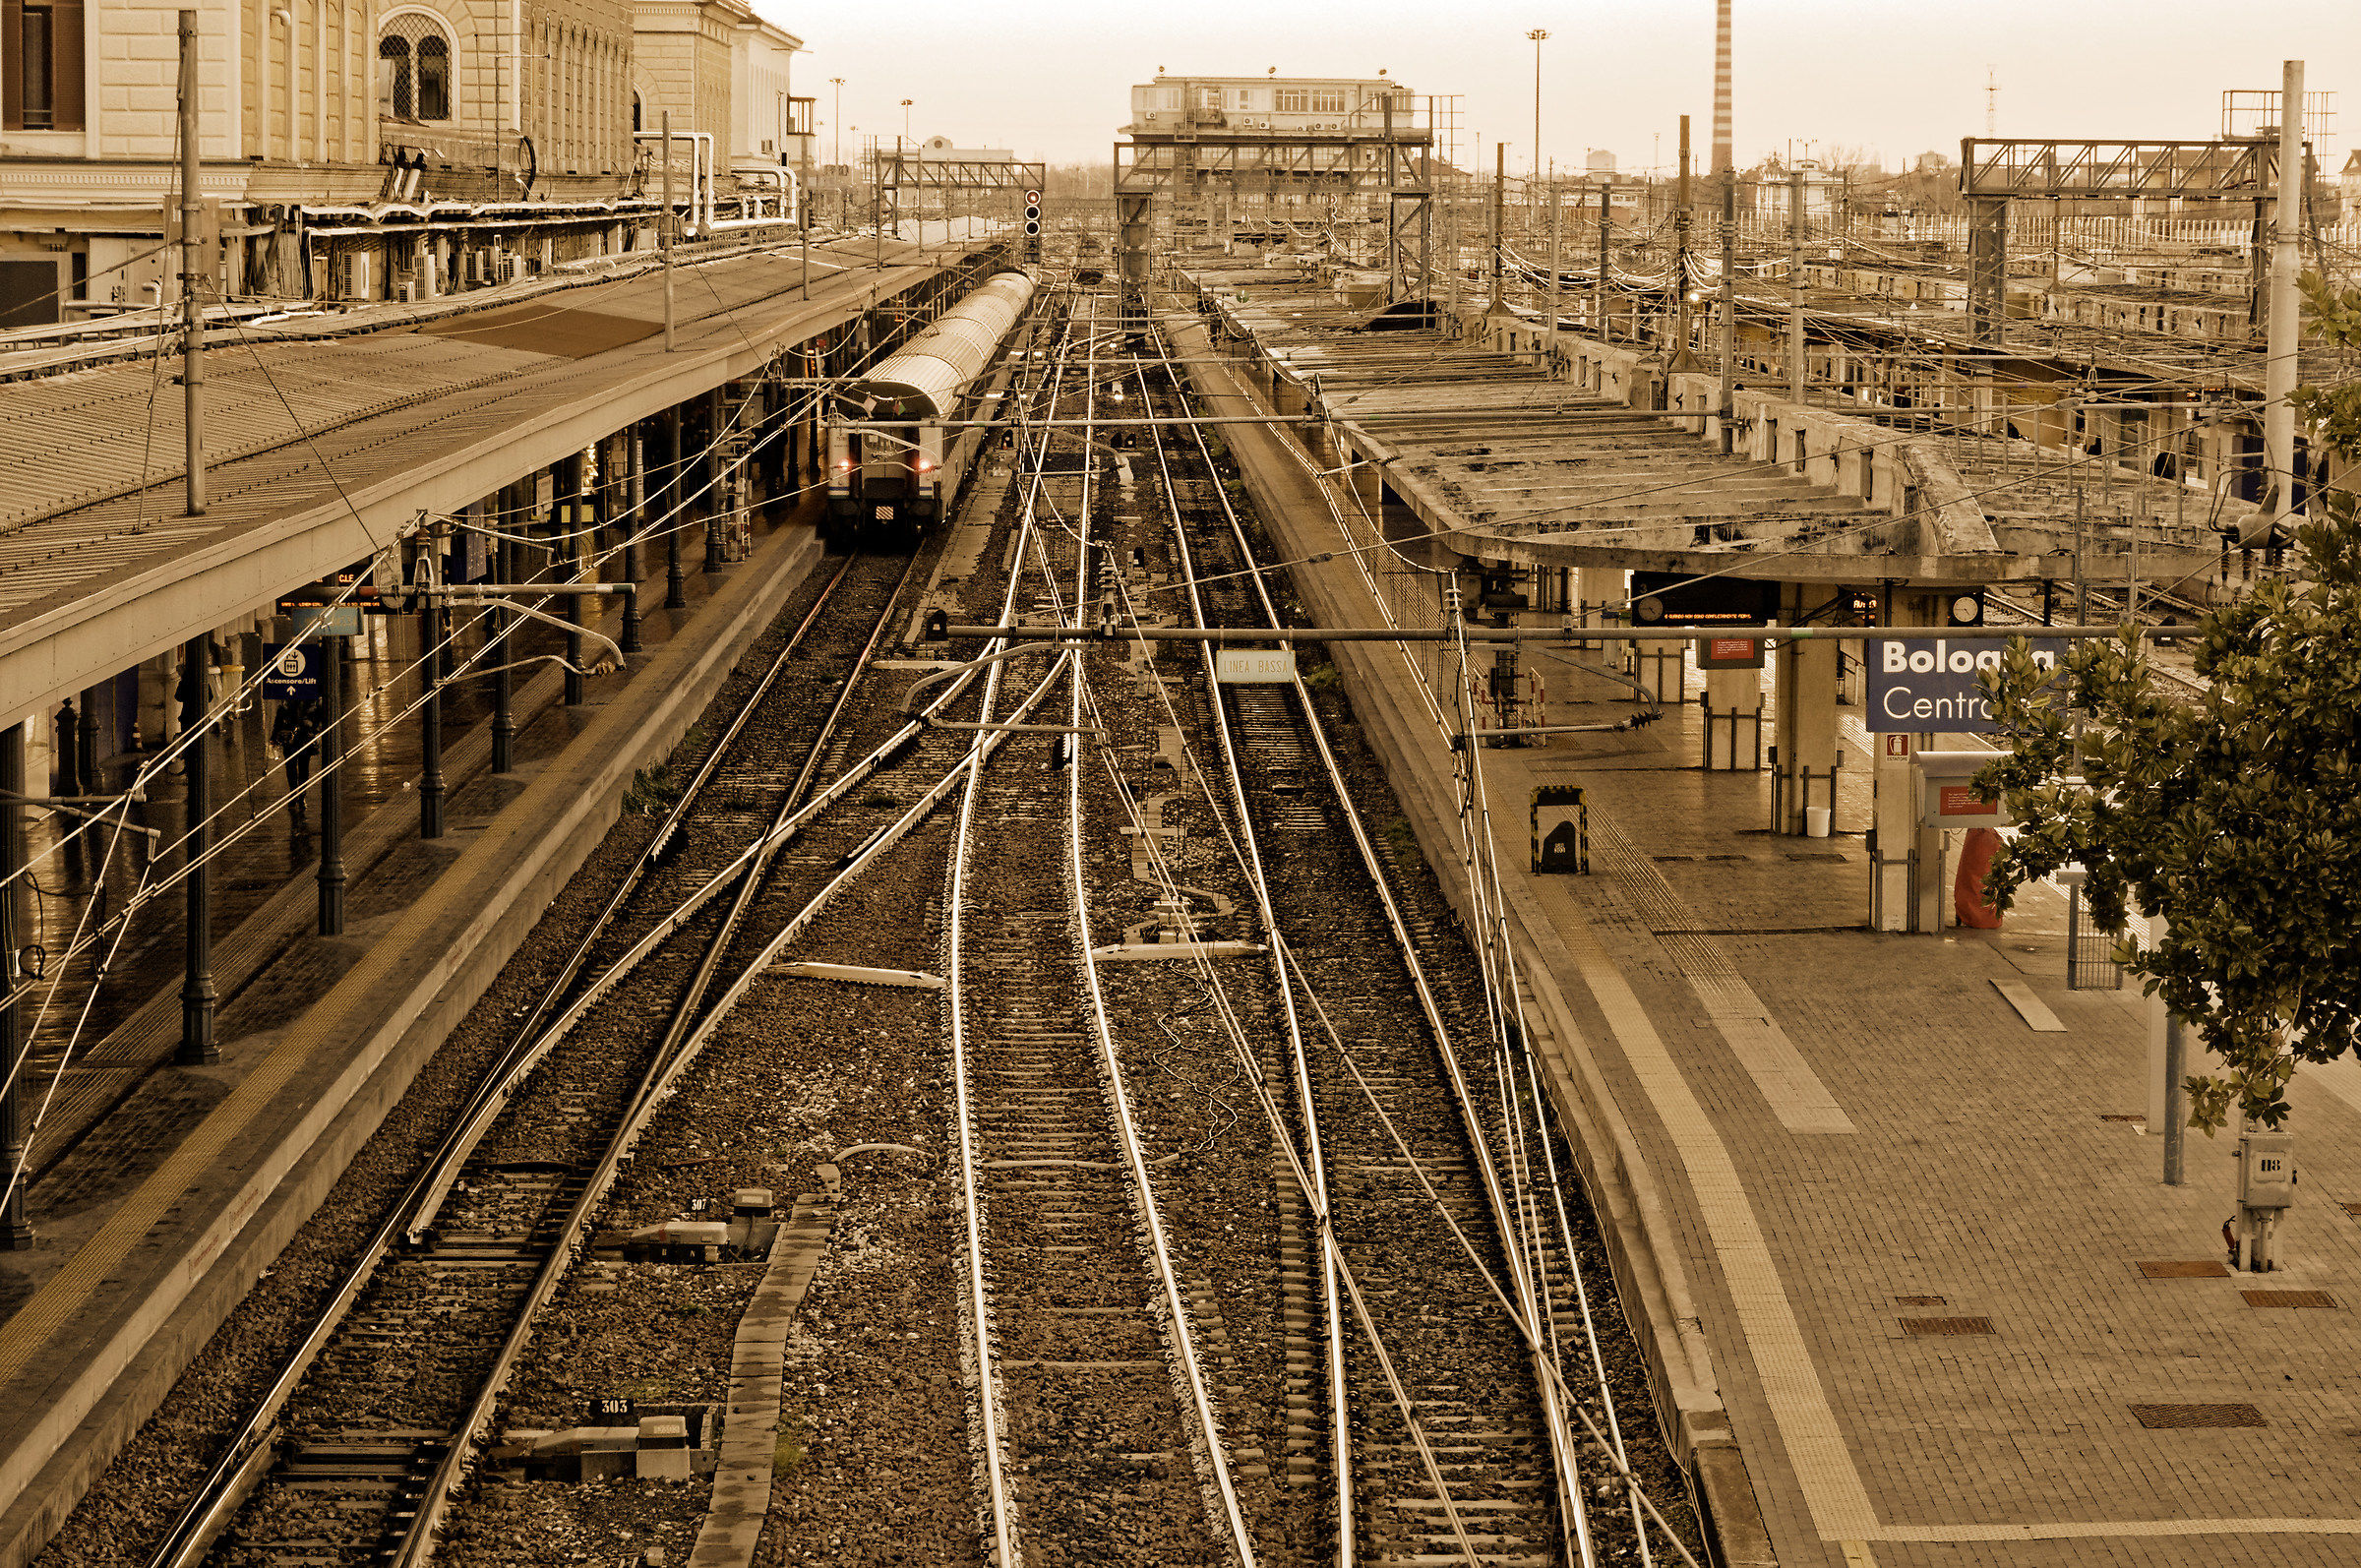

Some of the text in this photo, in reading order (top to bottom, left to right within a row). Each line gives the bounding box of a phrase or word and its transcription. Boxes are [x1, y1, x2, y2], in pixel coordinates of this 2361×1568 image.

[1224, 660, 1288, 673] LINEA BASSA
[2261, 1159, 2281, 1172] 118
[692, 1198, 707, 1211] 307
[601, 1399, 628, 1414] 303
